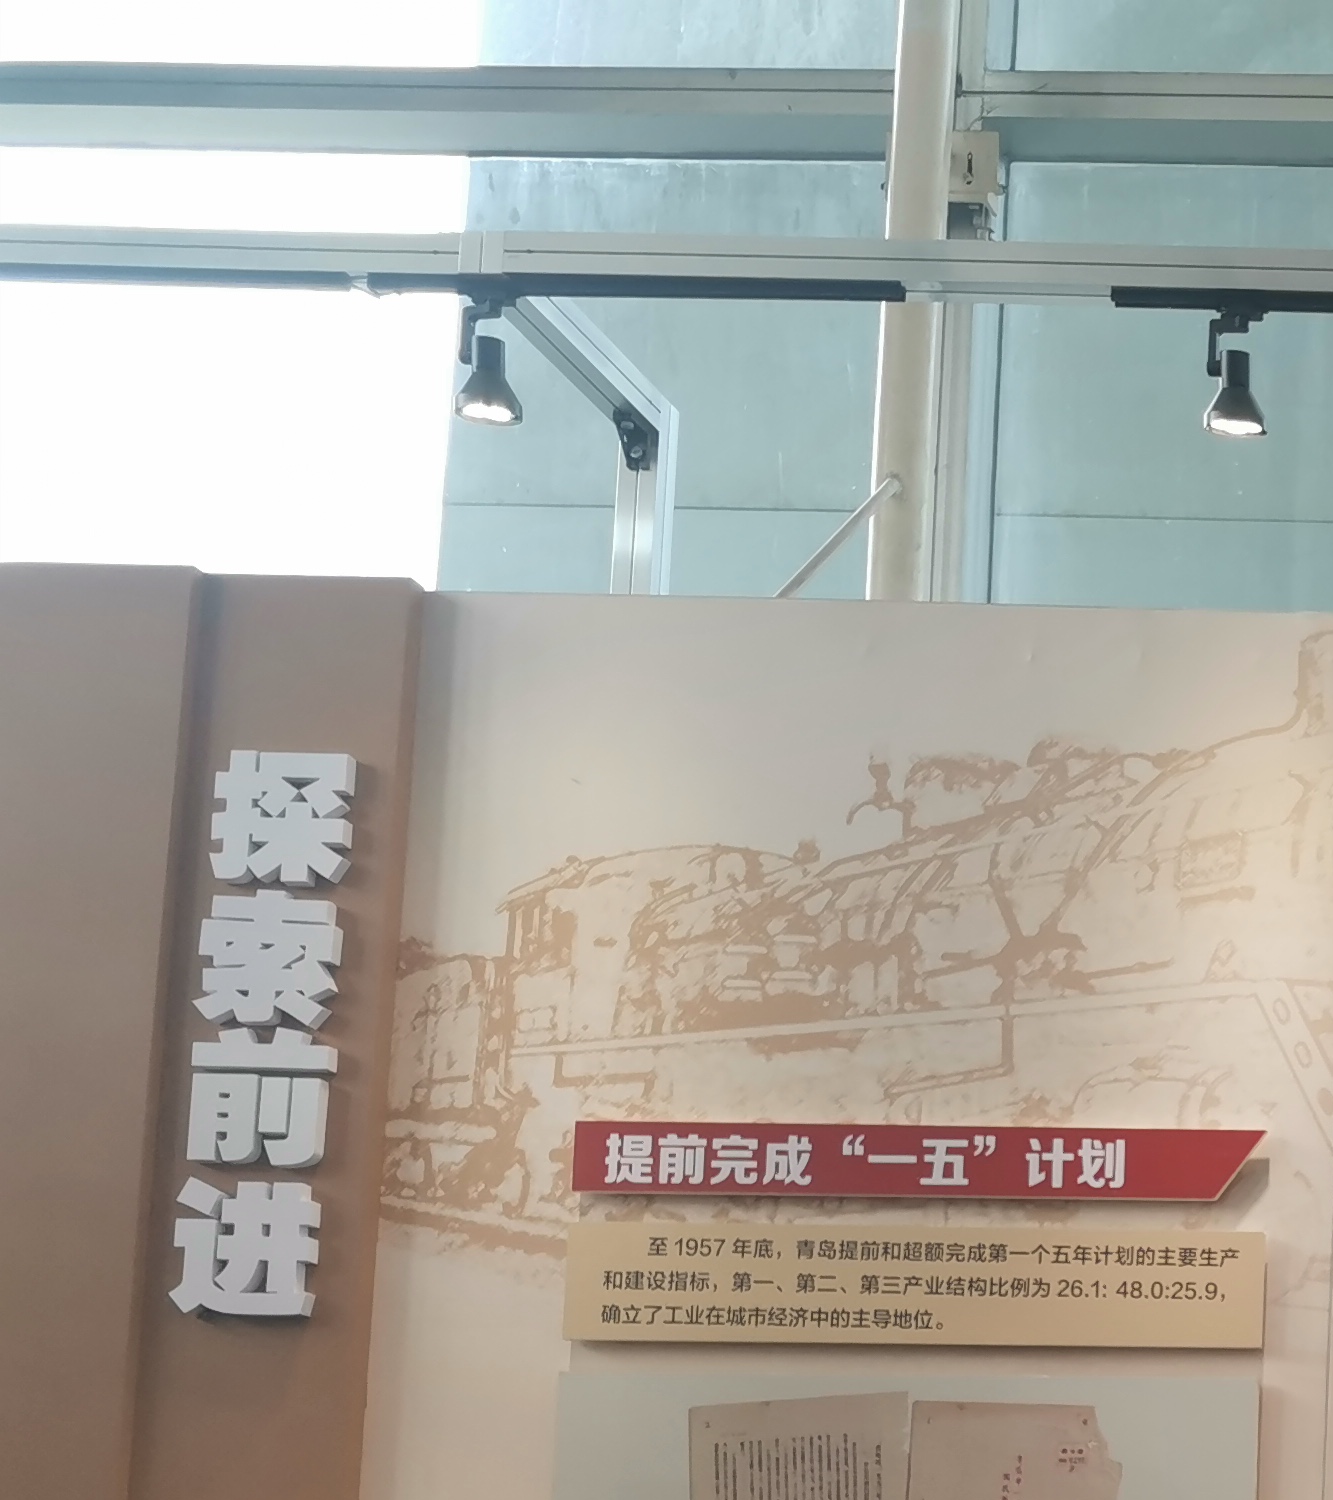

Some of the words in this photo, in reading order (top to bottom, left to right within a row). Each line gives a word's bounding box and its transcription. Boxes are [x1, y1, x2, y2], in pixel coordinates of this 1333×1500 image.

[168, 750, 357, 1317] 探索前进
[605, 1133, 1127, 1190] 提前完成“一五”计划
[600, 1303, 946, 1331] 确立了工业在城市经济中的主导地位。
